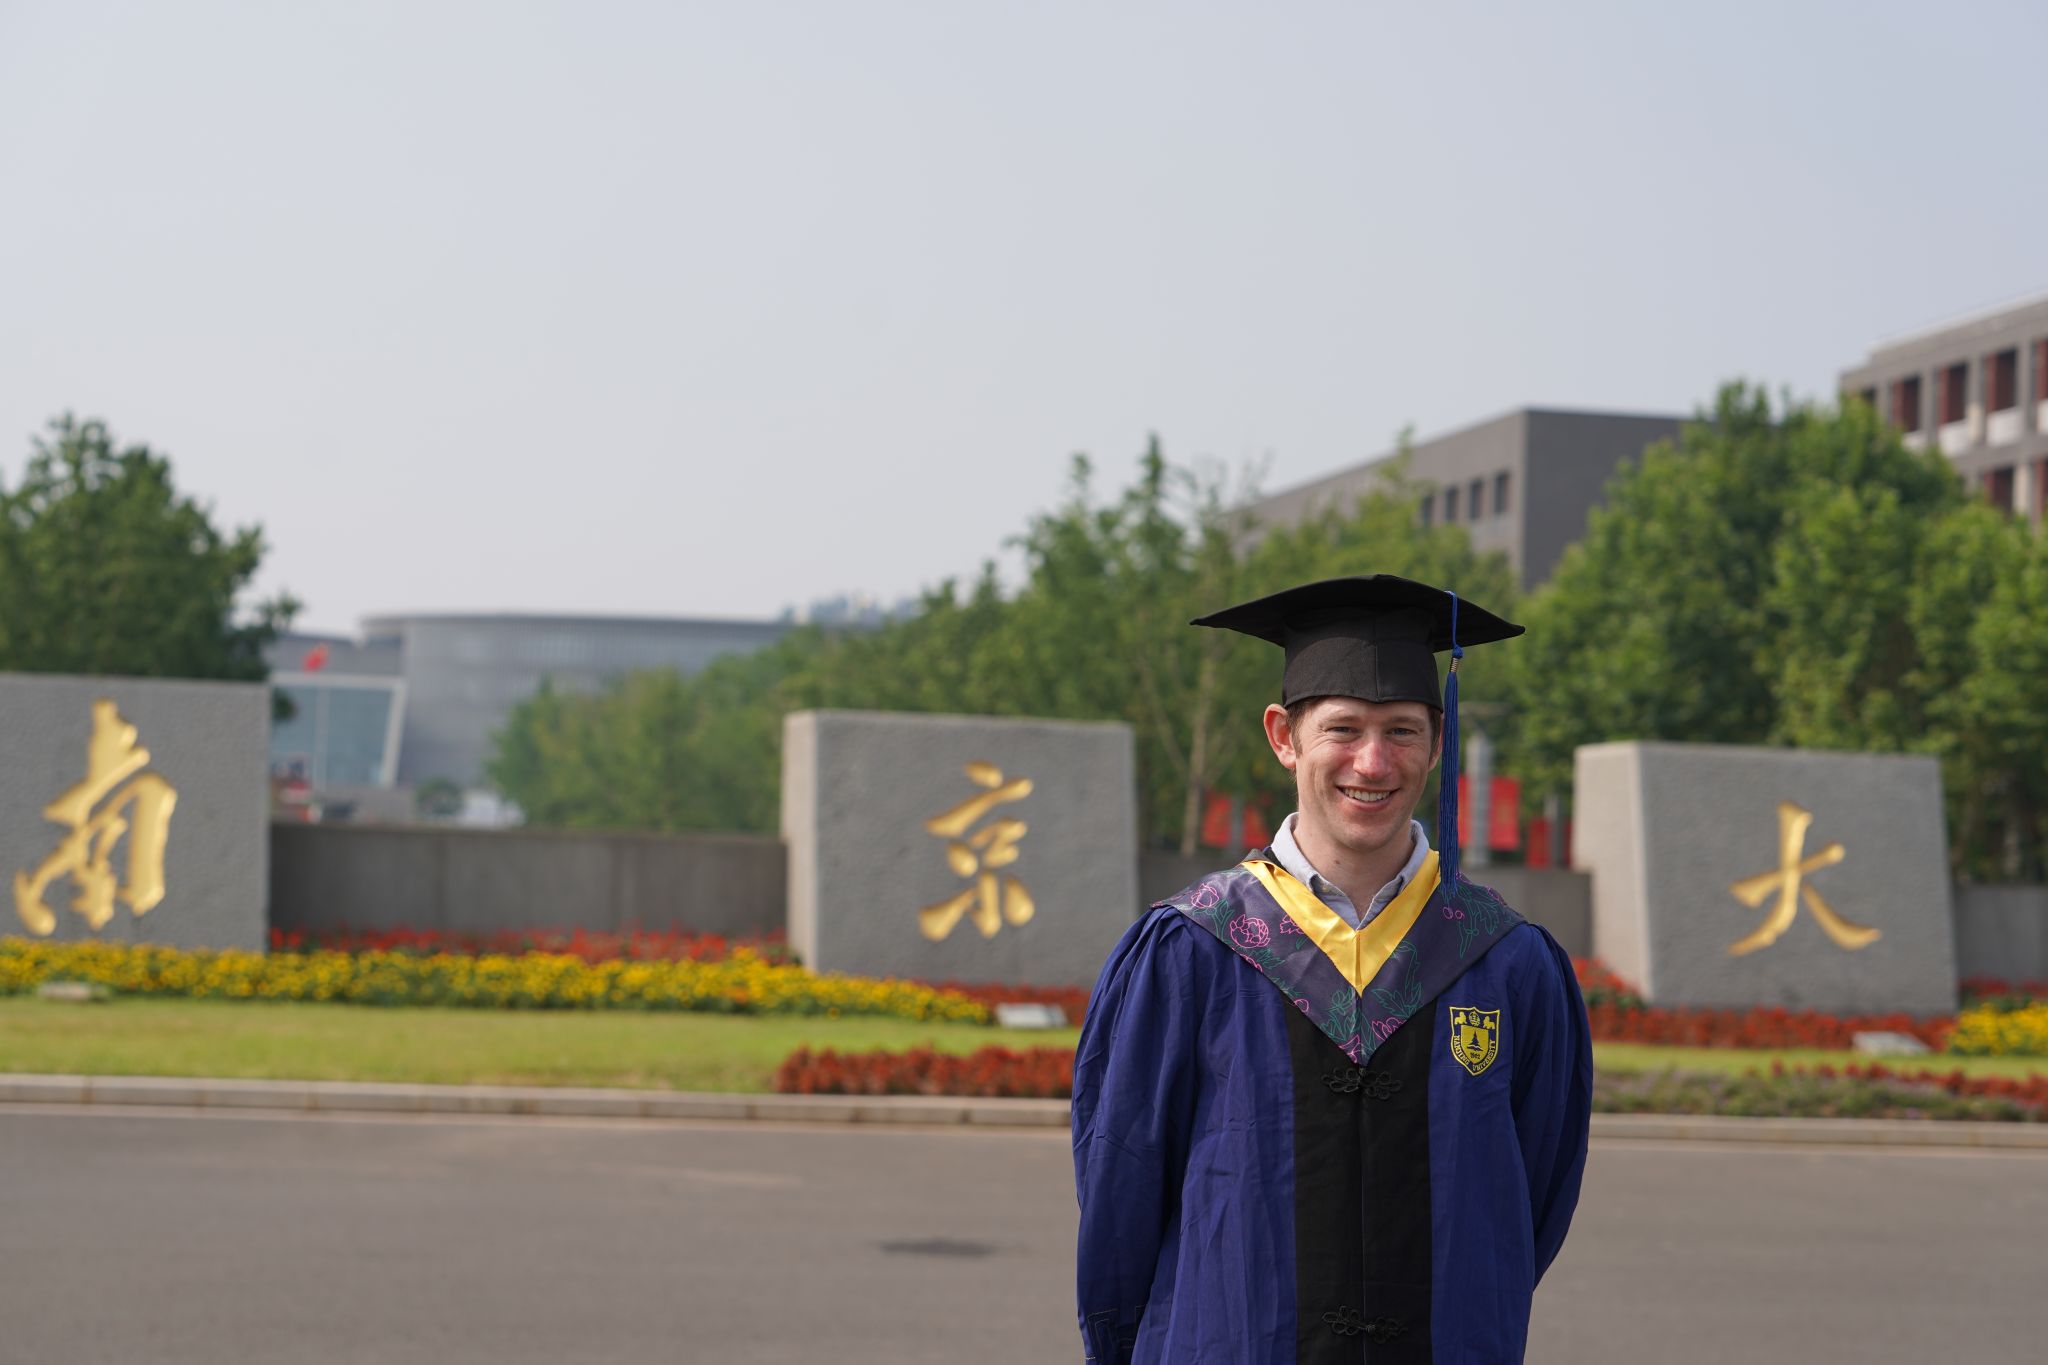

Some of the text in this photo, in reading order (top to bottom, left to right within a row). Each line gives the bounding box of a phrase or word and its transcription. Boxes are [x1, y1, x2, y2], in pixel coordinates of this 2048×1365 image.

[13, 698, 177, 936] 南
[919, 760, 1036, 942] 京
[1729, 801, 1881, 956] 大
